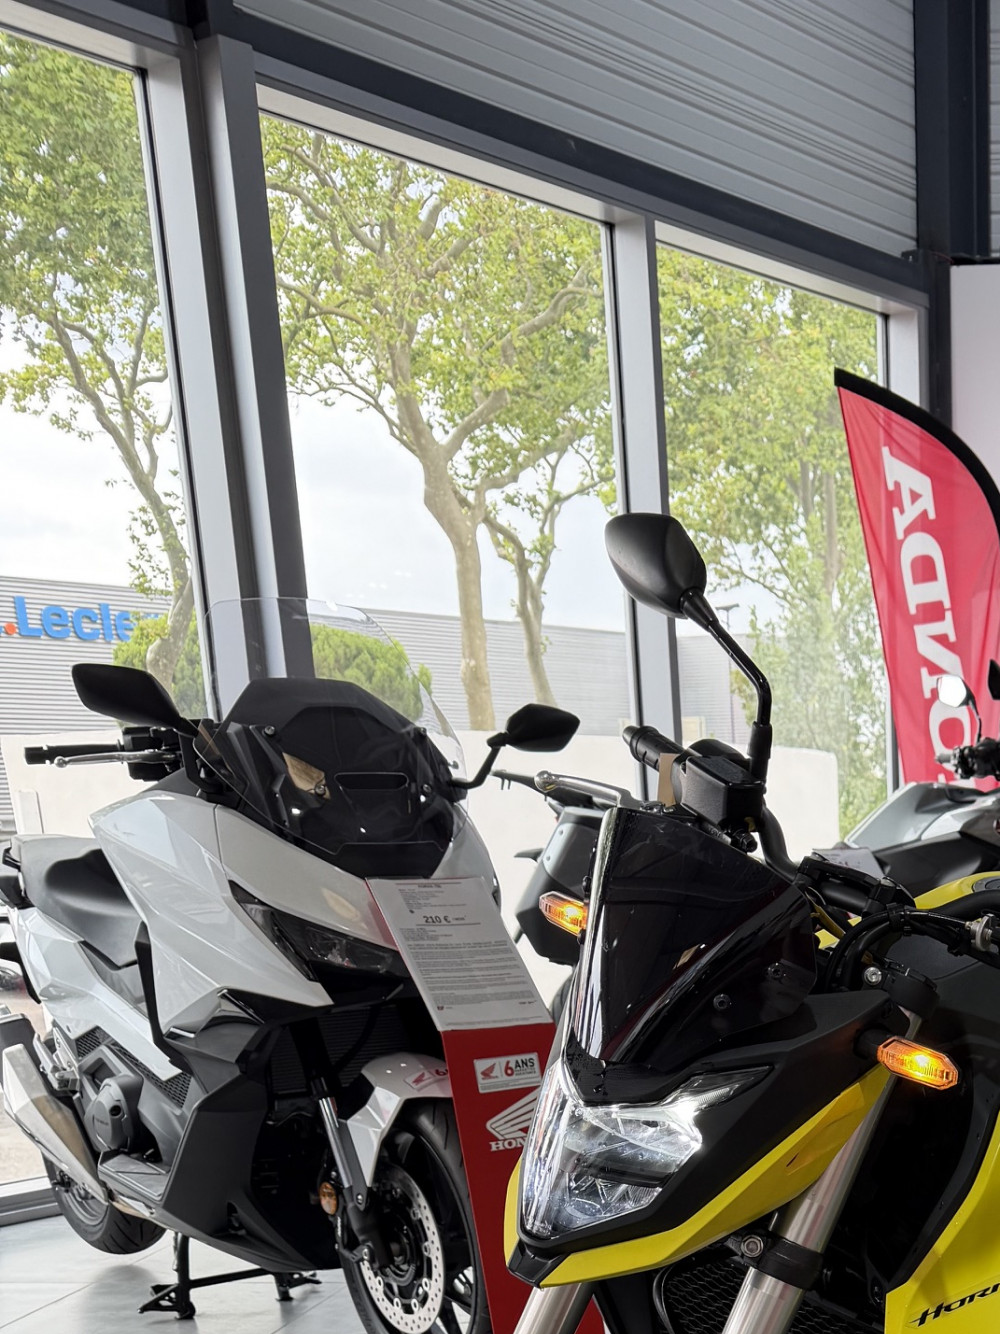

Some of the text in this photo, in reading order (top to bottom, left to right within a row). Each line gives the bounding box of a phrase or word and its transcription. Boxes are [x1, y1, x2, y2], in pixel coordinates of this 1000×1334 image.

[423, 915, 442, 924] 210
[444, 915, 451, 924] €
[504, 1060, 515, 1077] 6
[515, 1058, 535, 1069] ANS
[489, 1139, 527, 1152] HON
